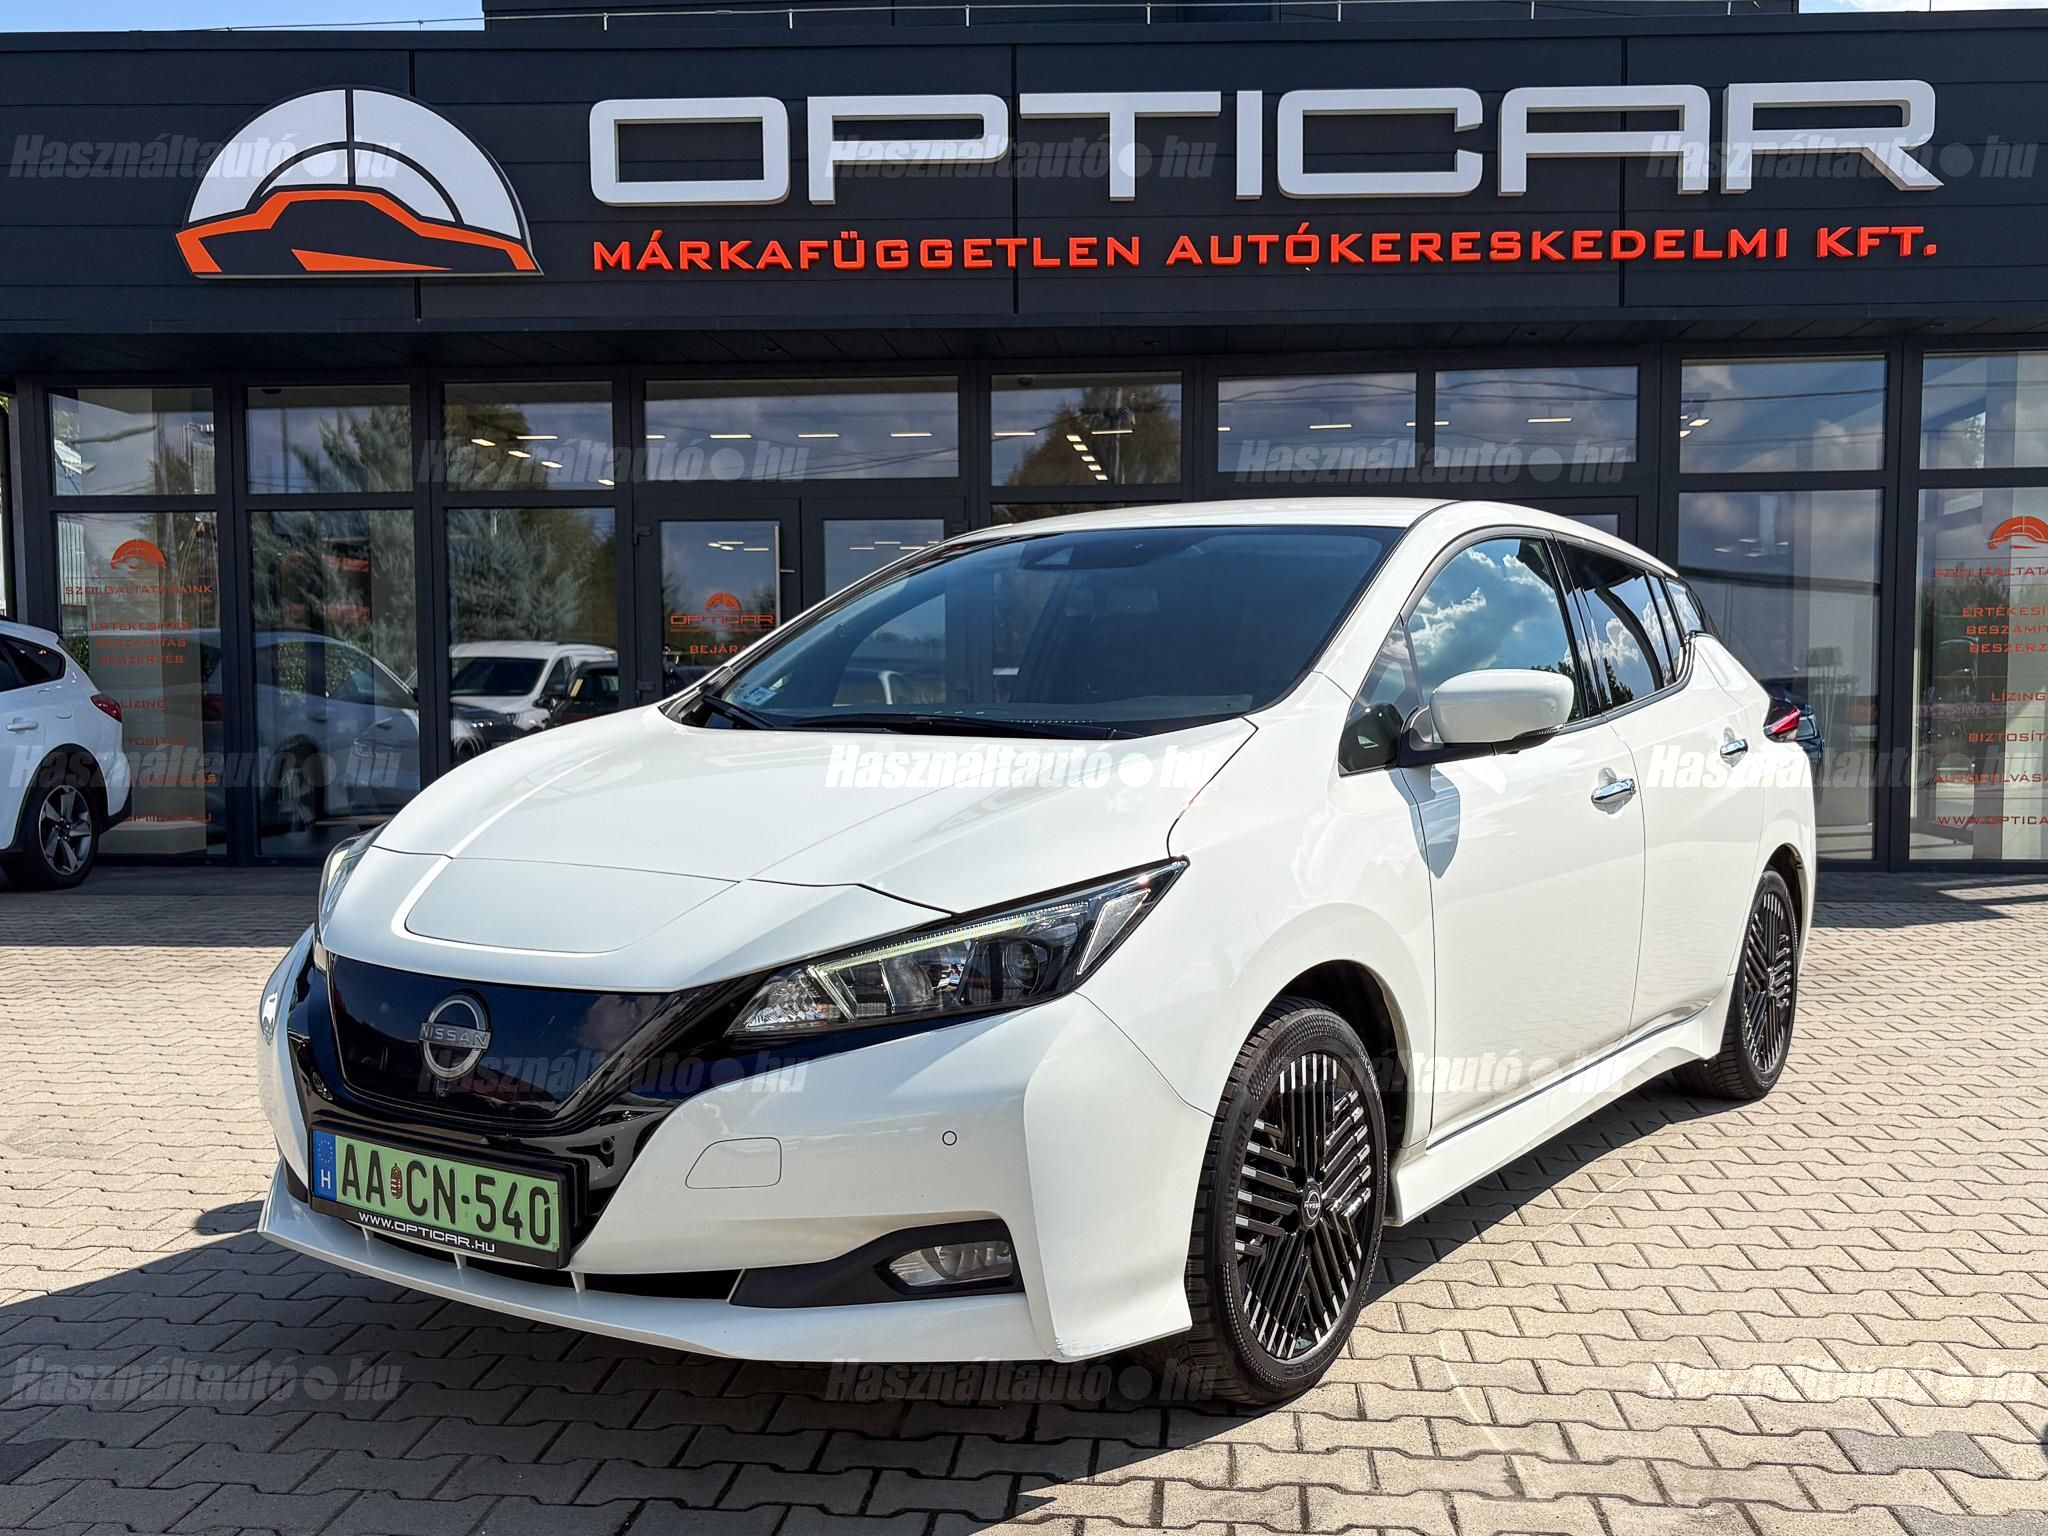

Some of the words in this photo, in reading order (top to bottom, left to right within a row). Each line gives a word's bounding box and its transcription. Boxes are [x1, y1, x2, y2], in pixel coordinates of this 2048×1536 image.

[589, 80, 1944, 205] OPTICAR
[593, 230, 1140, 271] MÁRKAFÜGGETLEN
[1165, 222, 1787, 265] AUTÓKERESKEDELMI
[1816, 226, 1937, 259] KFT.
[670, 614, 774, 625] OPTICAR
[1967, 730, 2048, 743] BIZTOSÍT
[421, 1024, 487, 1047] NISSAN
[321, 1169, 331, 1190] H
[358, 1211, 496, 1253] WWW.OPTICAR.HU
